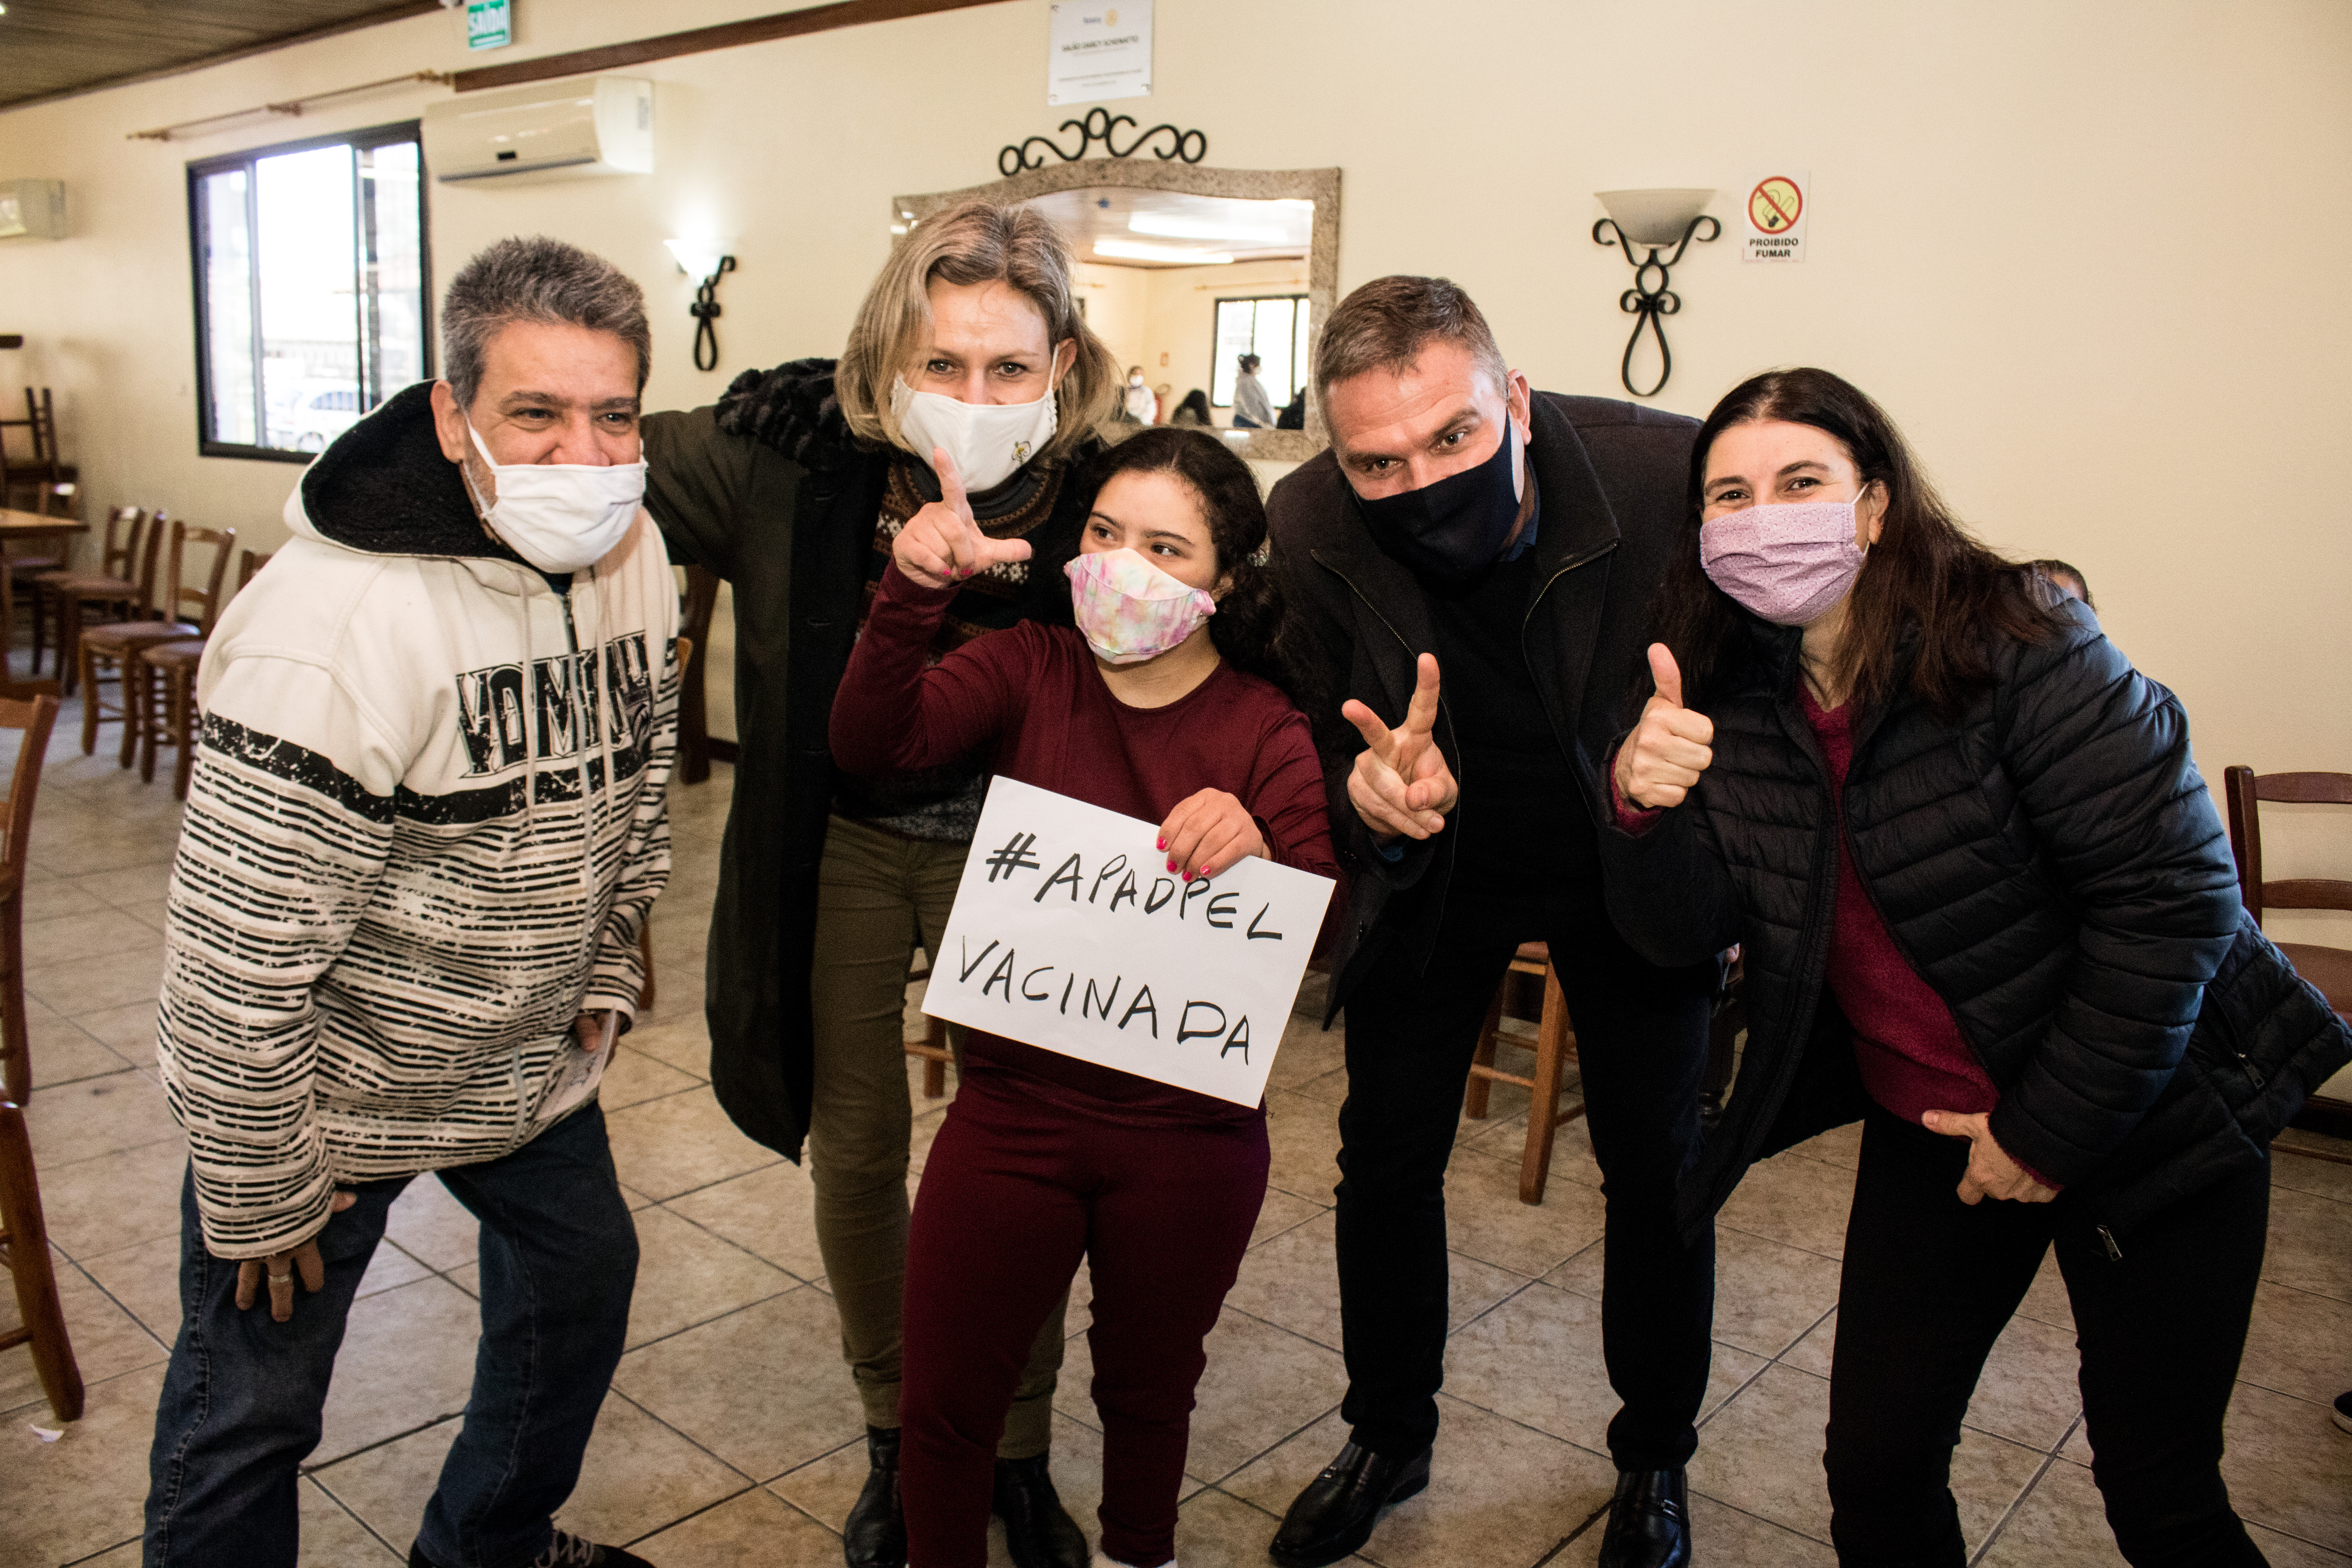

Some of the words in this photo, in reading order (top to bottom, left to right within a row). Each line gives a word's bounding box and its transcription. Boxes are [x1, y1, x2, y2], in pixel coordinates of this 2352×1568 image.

[468, 4, 507, 36] SAÍDA
[1749, 238, 1799, 247] PROIBIDO
[1755, 249, 1791, 258] FUMAR
[986, 832, 1283, 940] #APADPEL
[959, 935, 1249, 1065] VACINADA
